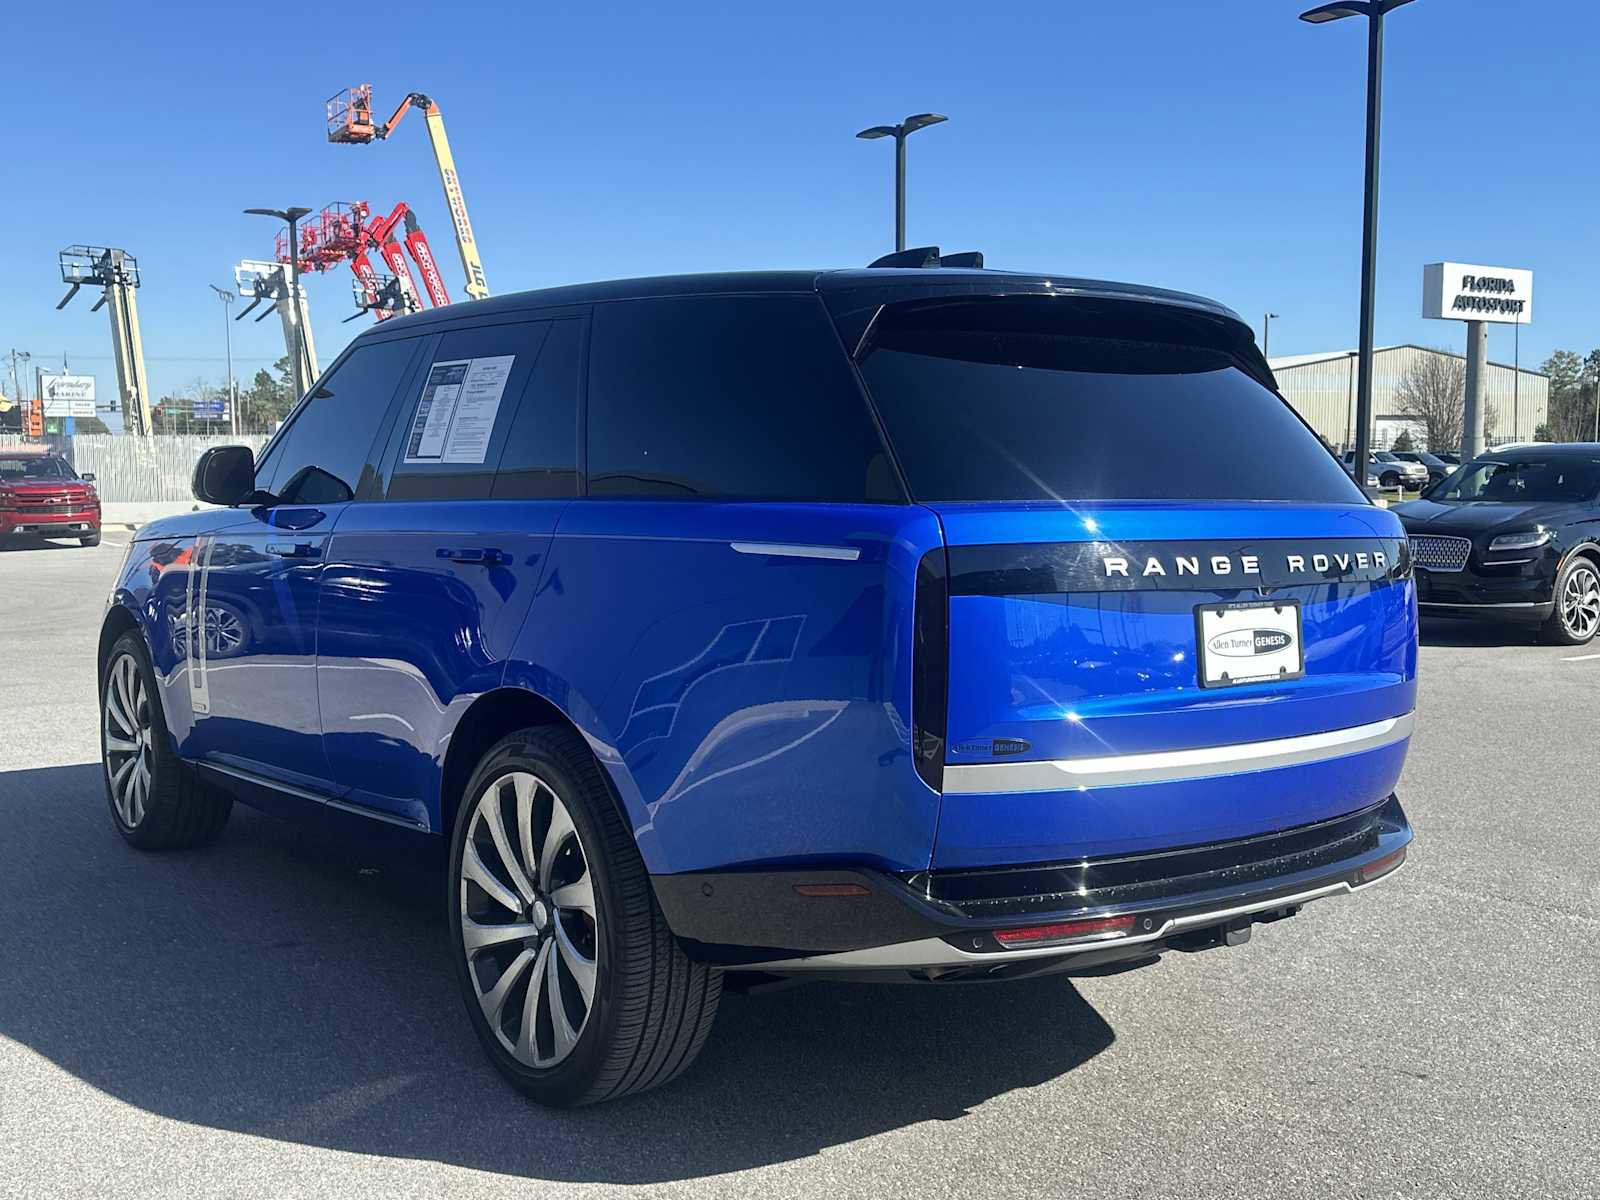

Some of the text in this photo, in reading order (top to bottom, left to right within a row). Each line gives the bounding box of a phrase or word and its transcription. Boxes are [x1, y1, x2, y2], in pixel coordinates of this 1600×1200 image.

[414, 241, 449, 306] SKYWOR
[470, 261, 486, 288] JLG
[1462, 275, 1515, 294] FLORIDA
[1451, 295, 1526, 314] AUTOSPORT
[1104, 551, 1387, 577] RANGE ROVER
[1213, 634, 1286, 650] Allen Turner GENESIS
